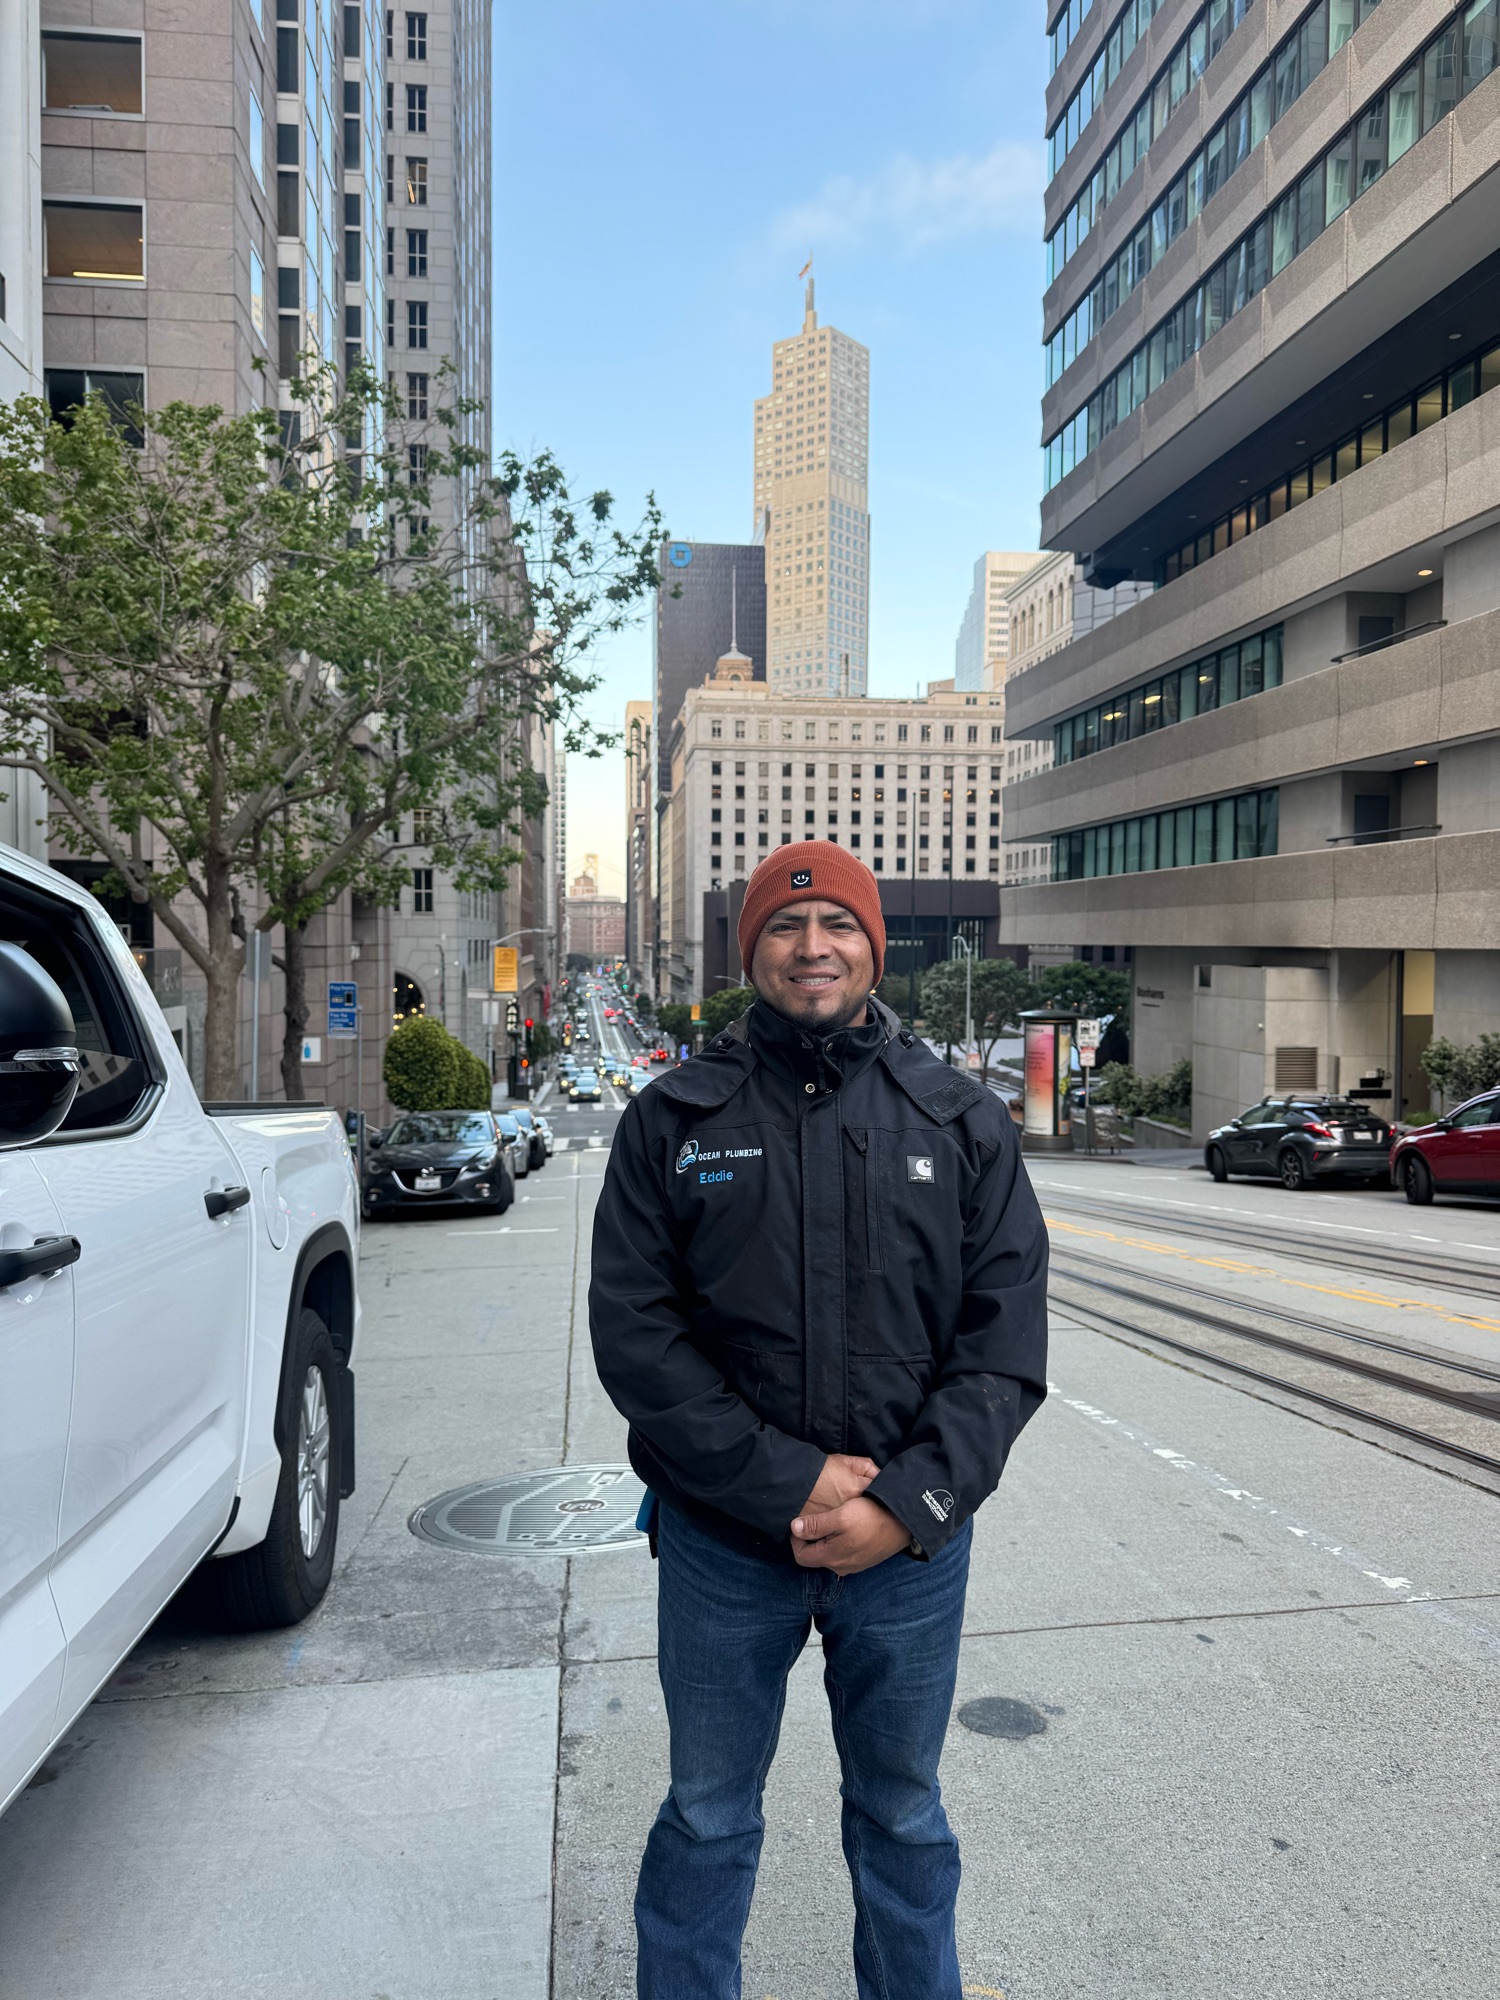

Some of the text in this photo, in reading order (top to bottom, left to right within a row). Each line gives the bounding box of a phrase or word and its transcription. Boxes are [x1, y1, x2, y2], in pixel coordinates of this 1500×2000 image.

[698, 1148, 763, 1161] OCEAN PLUMBING
[699, 1169, 734, 1184] Eddie
